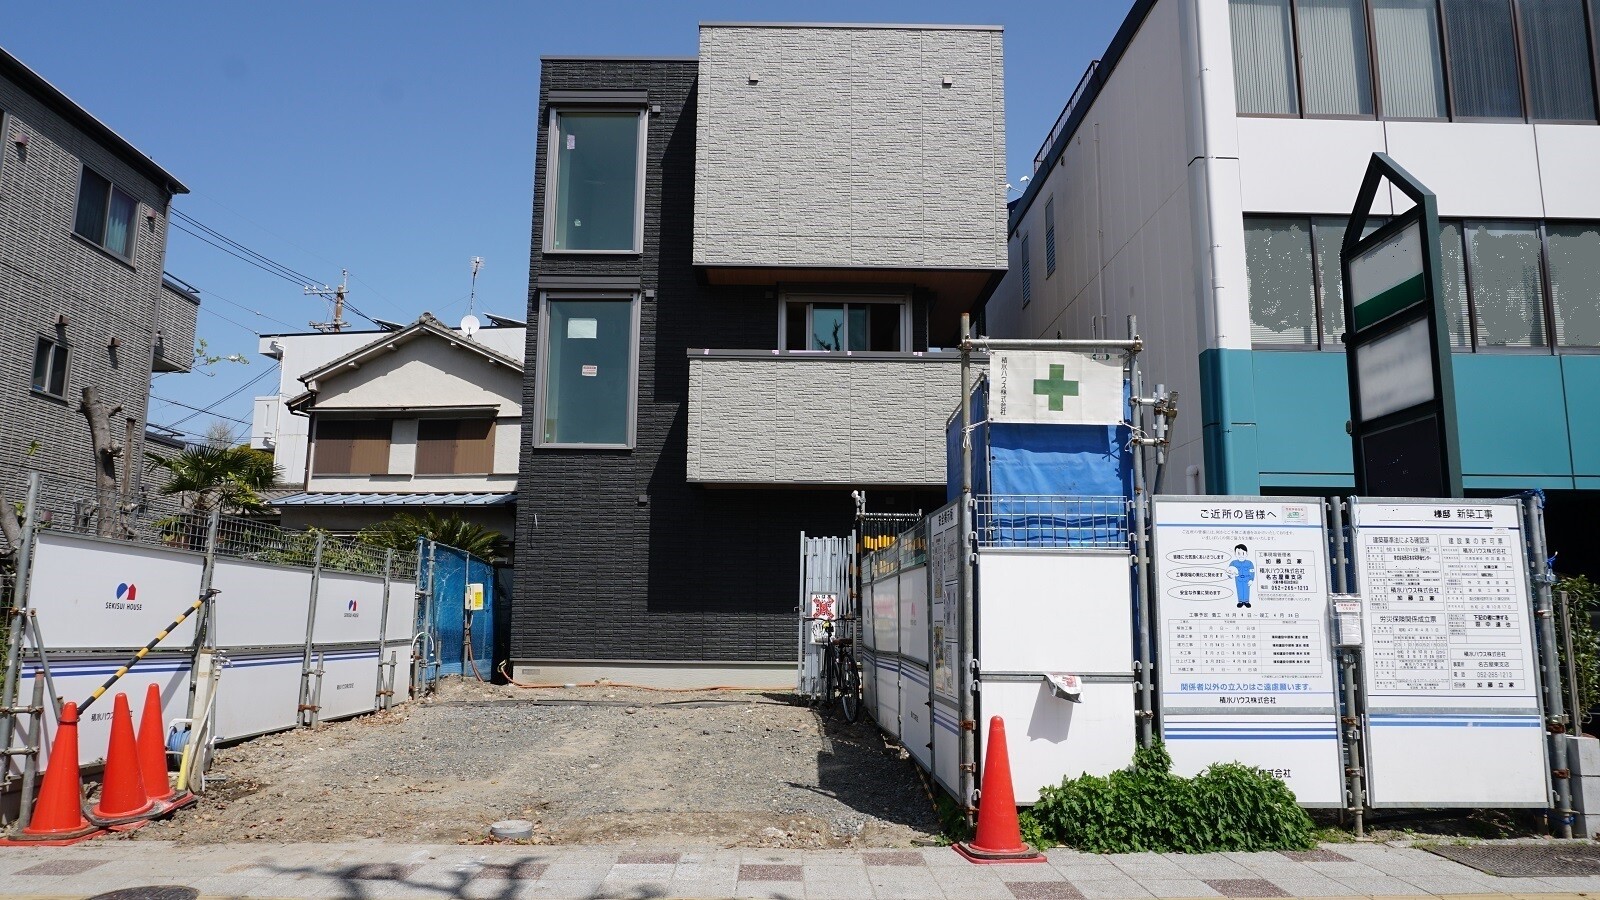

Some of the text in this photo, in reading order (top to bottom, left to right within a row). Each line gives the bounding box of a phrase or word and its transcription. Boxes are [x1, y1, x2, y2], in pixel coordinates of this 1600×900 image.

[1000, 356, 1008, 416] 積水ハウス株式会社
[1200, 508, 1277, 520] ご近所の皆様へ
[1457, 508, 1493, 520] 新築工事
[1448, 537, 1503, 545] 建設業の許可票
[1462, 547, 1506, 555] 積水ハウス株式会社
[1390, 586, 1440, 594] 積水ハウス株式会社
[105, 601, 142, 611] SEKISUI HOUSE
[1379, 615, 1437, 623] 労災保険関係成立票
[1180, 682, 1312, 692] 関係者以外の立入りはご遠慮願います。
[1219, 696, 1277, 704] 積水ハウス株式会社
